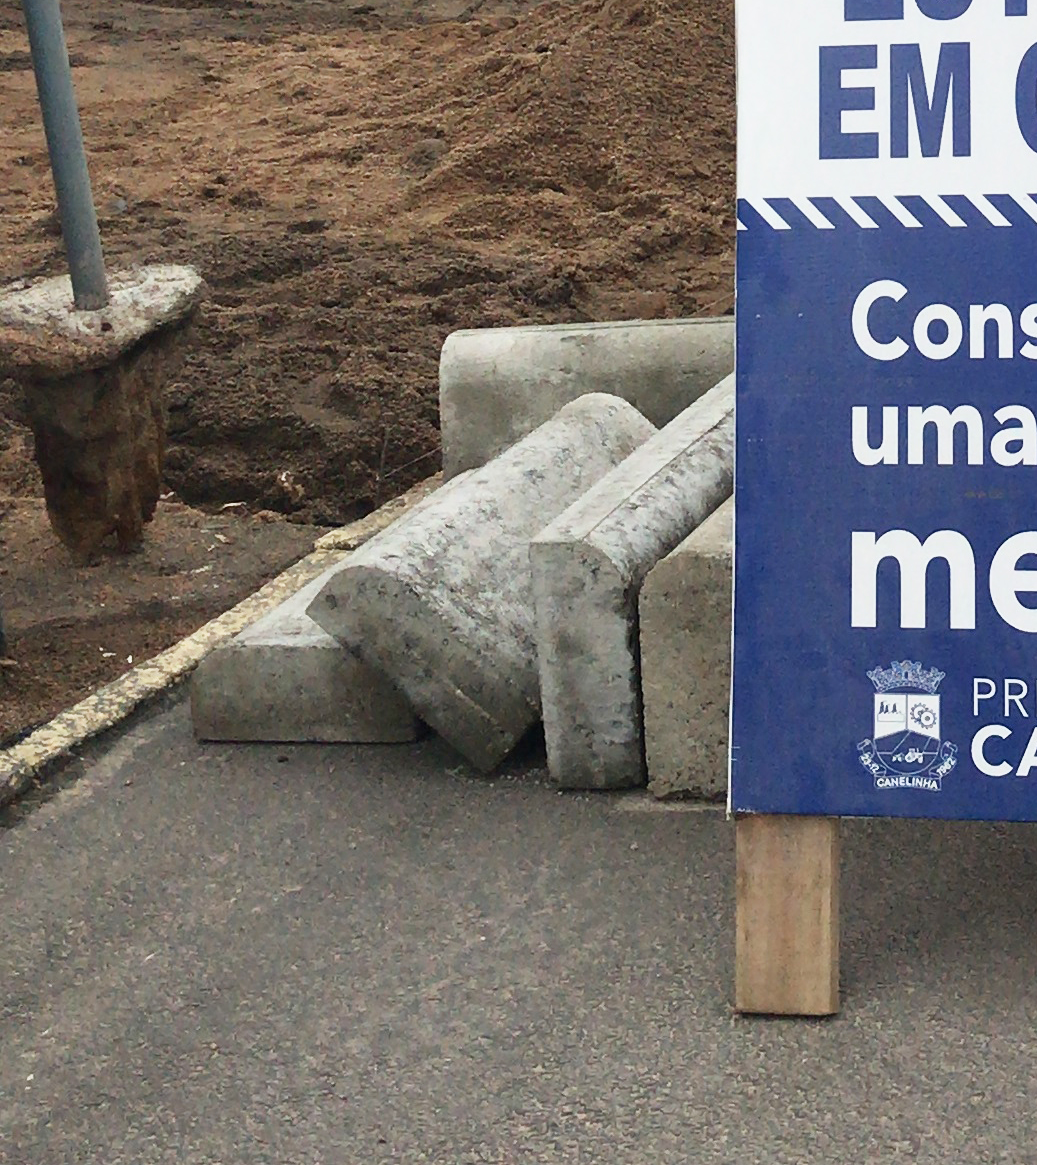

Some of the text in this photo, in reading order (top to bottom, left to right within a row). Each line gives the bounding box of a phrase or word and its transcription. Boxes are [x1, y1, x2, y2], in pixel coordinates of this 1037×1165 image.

[819, 42, 971, 159] EM
[851, 404, 1037, 467] uma
[876, 776, 938, 789] CANELINHA
